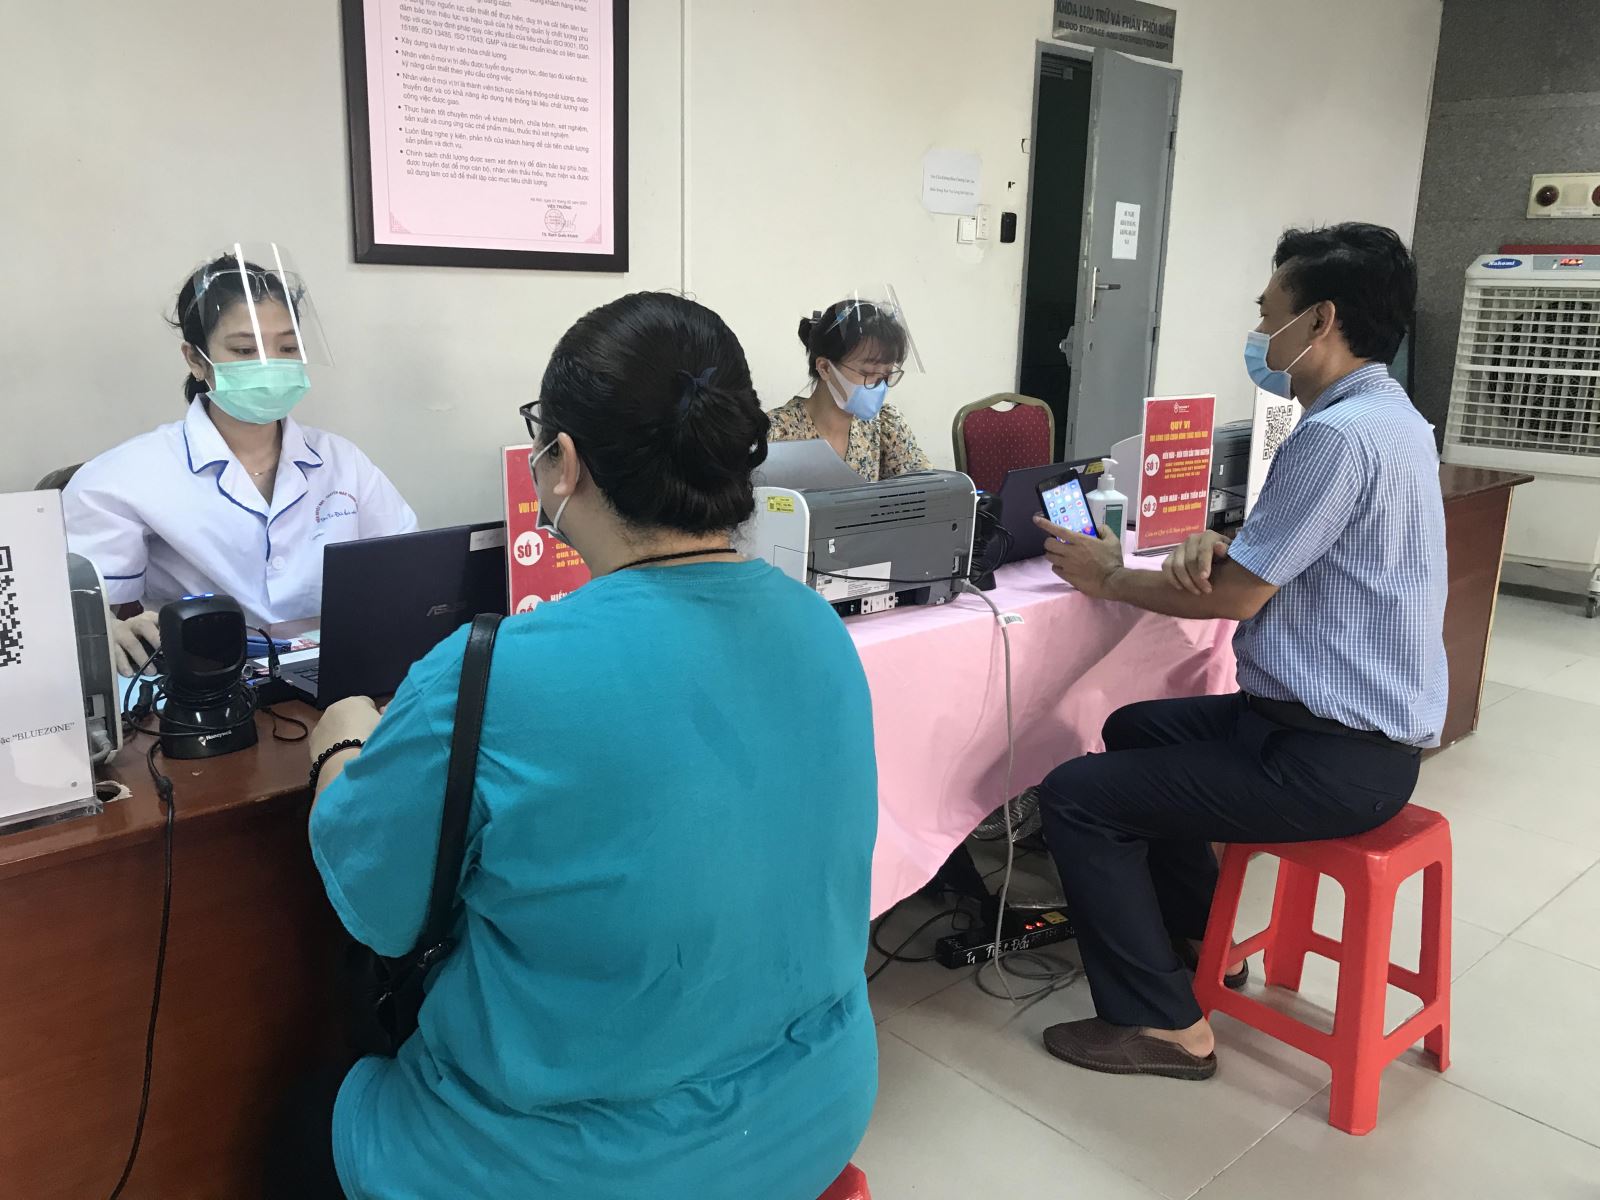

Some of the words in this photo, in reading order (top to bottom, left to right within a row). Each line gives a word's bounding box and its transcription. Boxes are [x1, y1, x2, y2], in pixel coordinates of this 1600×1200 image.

[1059, 20, 1078, 32] BLOOD
[1080, 24, 1105, 38] STORAGE
[518, 502, 529, 513] VUI
[518, 539, 532, 558] SỐ
[535, 542, 541, 556] 1
